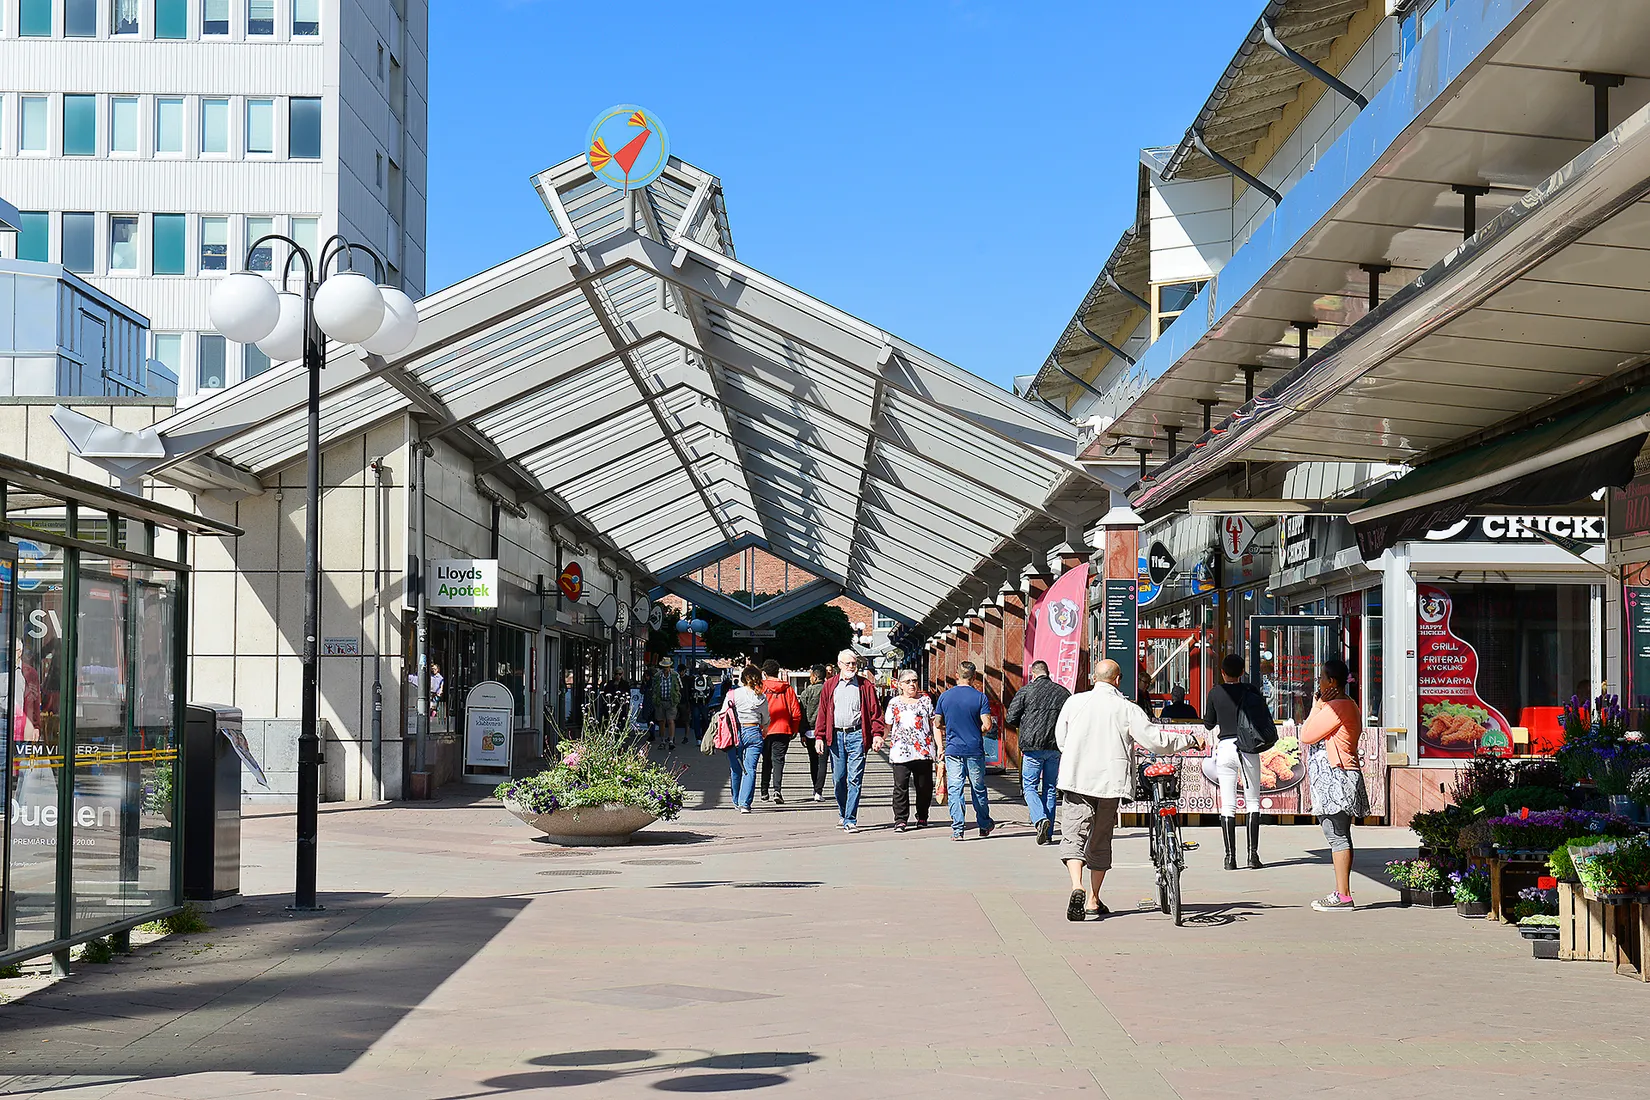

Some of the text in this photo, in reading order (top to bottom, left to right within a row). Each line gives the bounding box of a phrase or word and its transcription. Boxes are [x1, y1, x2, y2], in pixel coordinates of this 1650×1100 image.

[1625, 495, 1650, 531] BLO
[1482, 516, 1606, 539] CHICK
[437, 566, 482, 583] Lloyds
[437, 583, 490, 600] Apotek
[1431, 642, 1459, 651] GRILL
[1423, 655, 1468, 664] FRITERAD
[1419, 676, 1473, 685] SHAWARMA
[15, 744, 43, 756] VEM
[1189, 797, 1214, 809] 989
